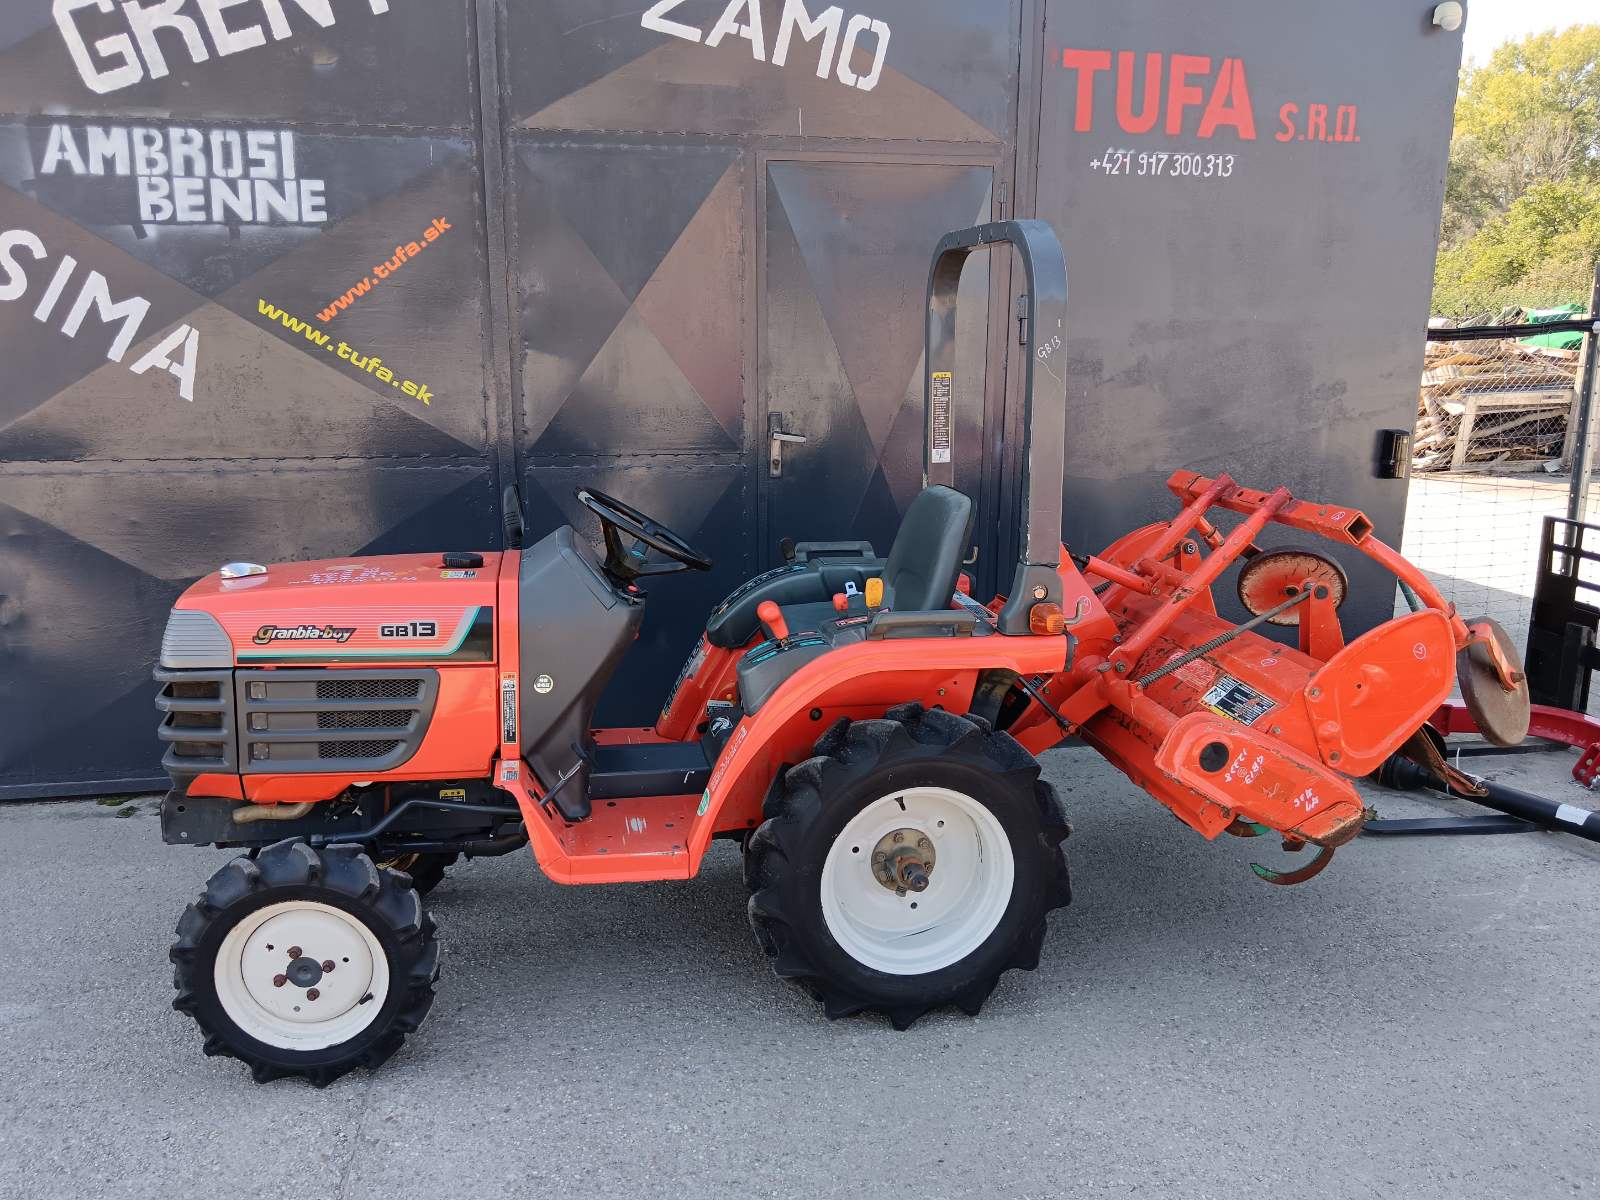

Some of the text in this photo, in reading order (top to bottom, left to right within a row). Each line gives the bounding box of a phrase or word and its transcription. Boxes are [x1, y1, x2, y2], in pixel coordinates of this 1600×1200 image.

[1062, 48, 1257, 140] TUFA
[41, 124, 296, 179] AMBROSI
[1089, 153, 1235, 177] +421 917 300 313
[136, 176, 328, 223] BENNE
[315, 215, 452, 325] www.tufa.sk
[0, 228, 200, 402] SIMA
[257, 298, 434, 405] www.tufa.sk
[378, 620, 440, 640] GB13
